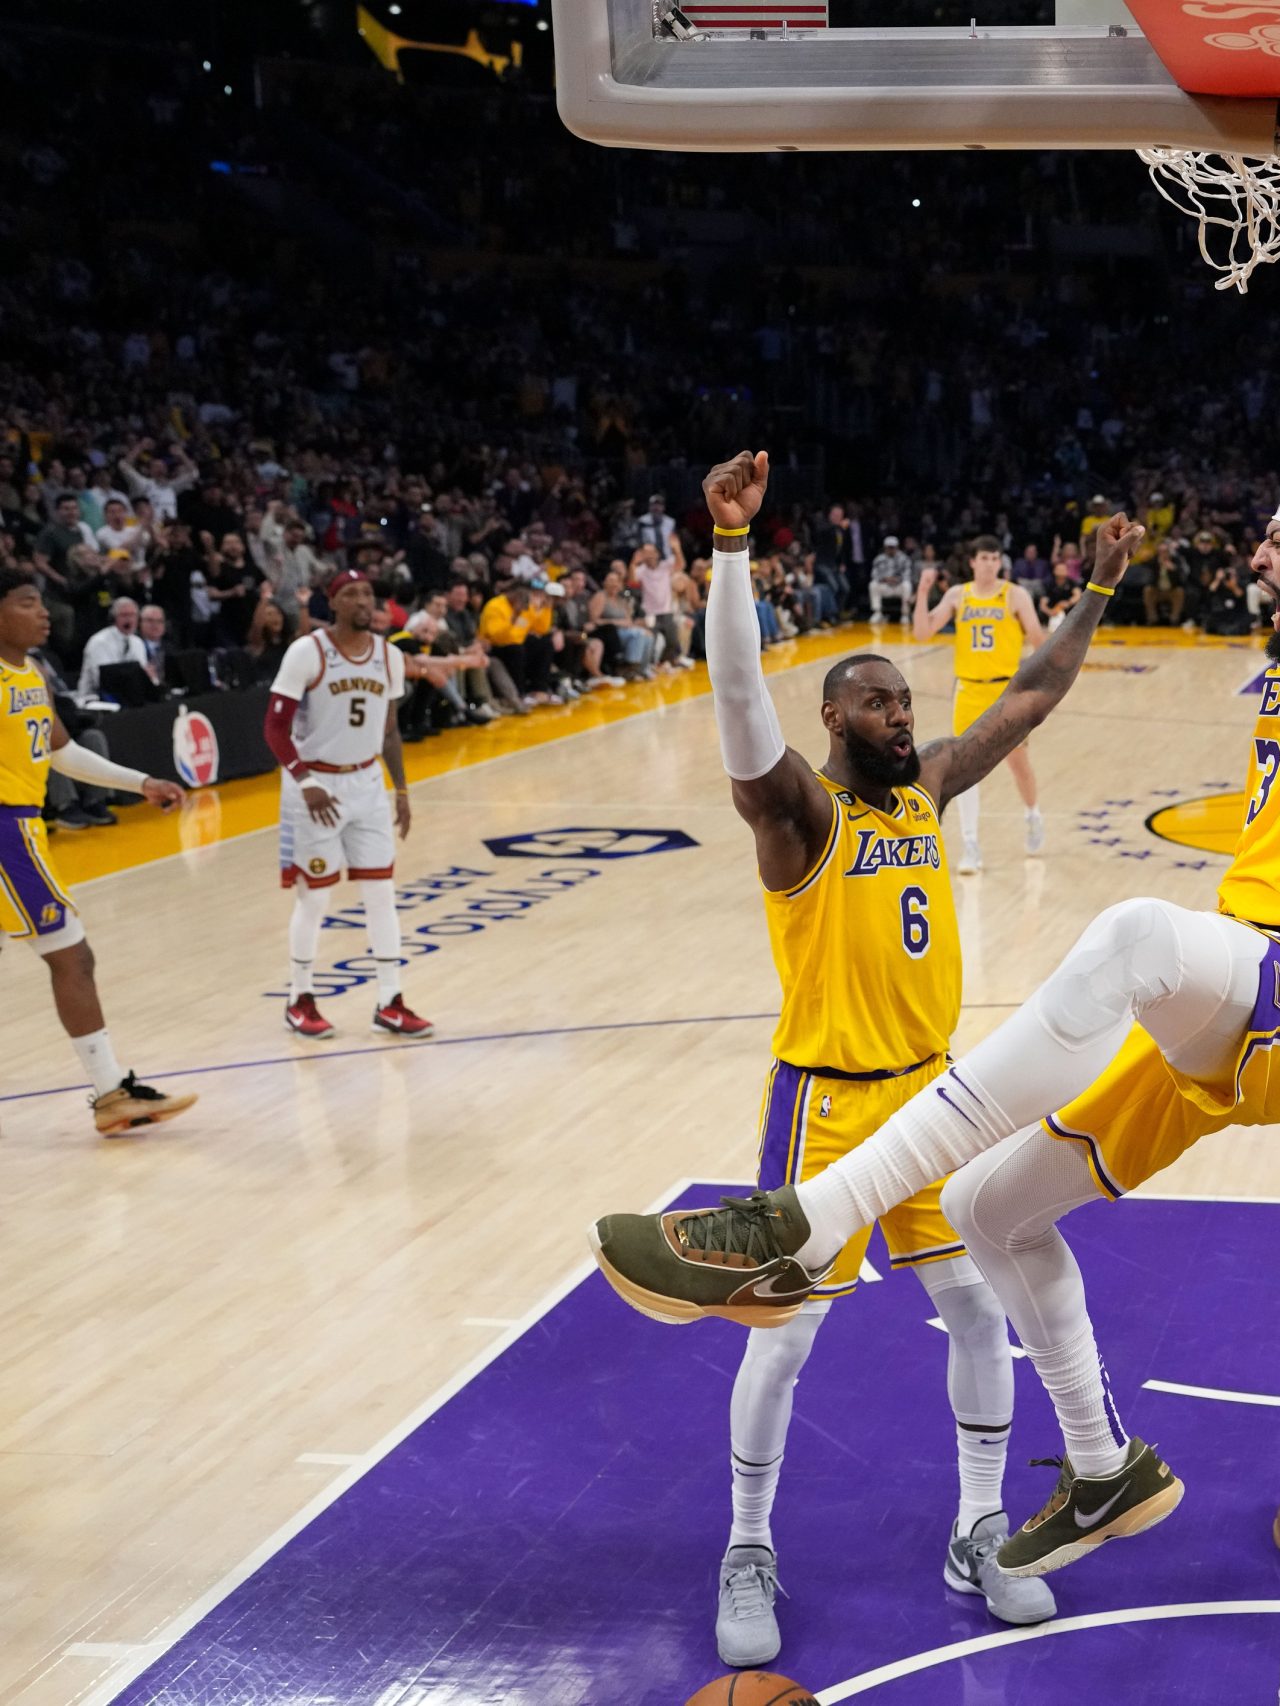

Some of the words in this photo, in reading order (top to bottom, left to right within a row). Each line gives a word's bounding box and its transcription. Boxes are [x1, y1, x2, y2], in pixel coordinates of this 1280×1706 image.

[972, 623, 995, 653] 15
[328, 678, 385, 696] DENVER
[349, 697, 366, 728] 5
[1245, 736, 1280, 831] 3
[843, 829, 941, 878] LAKERS
[899, 884, 931, 960] 6
